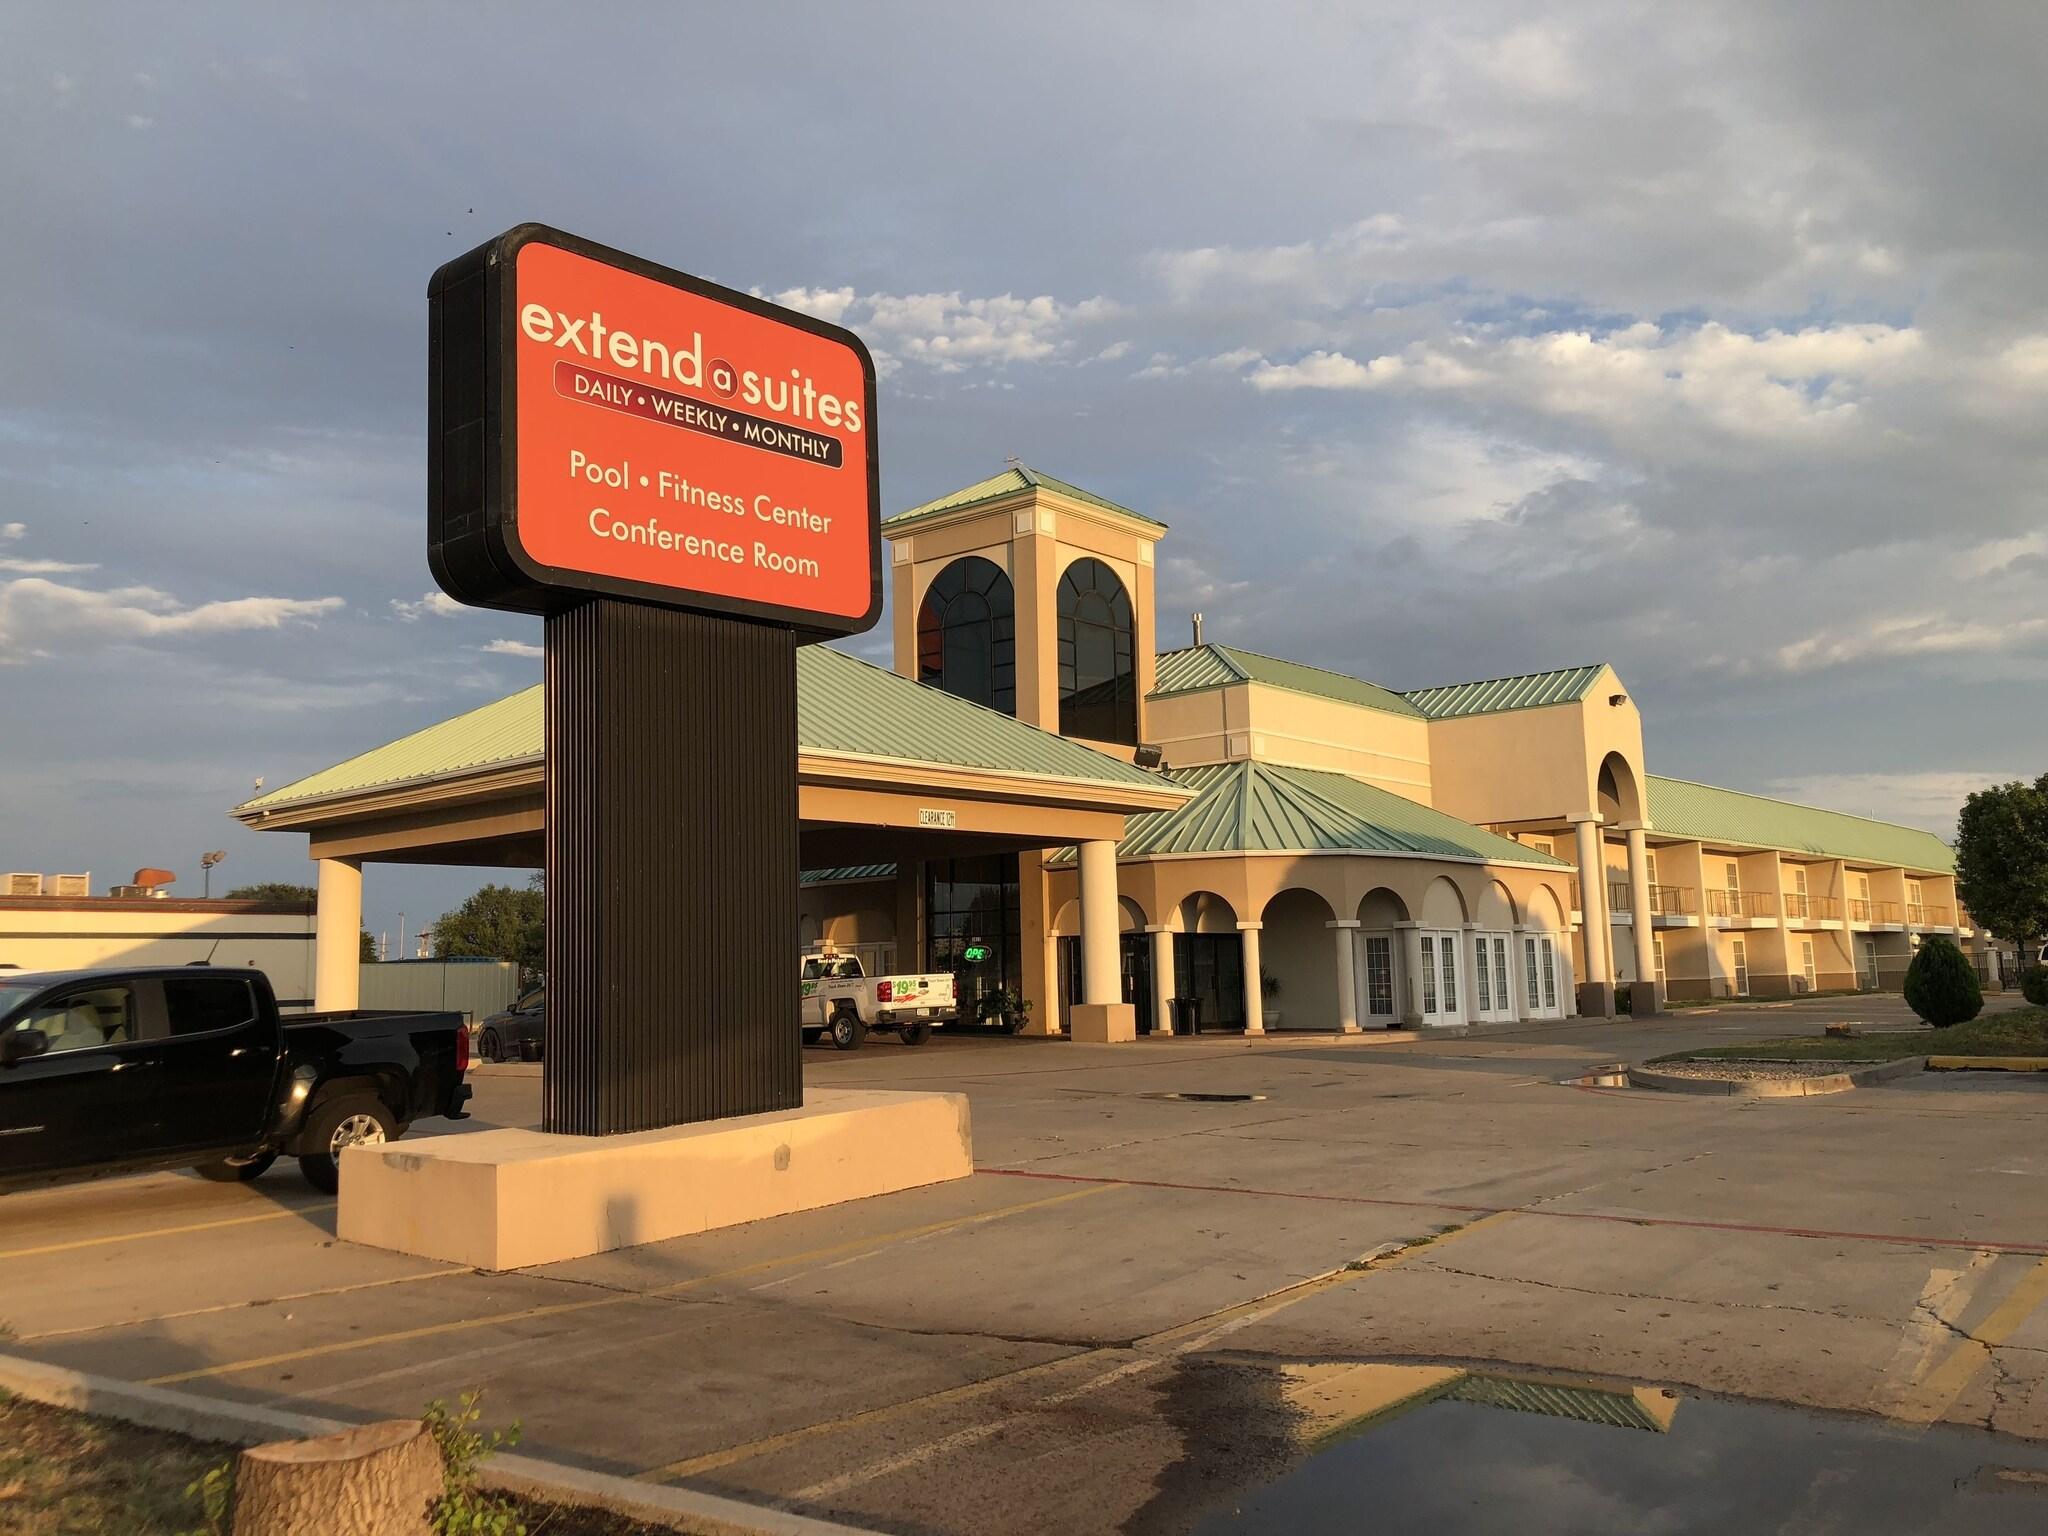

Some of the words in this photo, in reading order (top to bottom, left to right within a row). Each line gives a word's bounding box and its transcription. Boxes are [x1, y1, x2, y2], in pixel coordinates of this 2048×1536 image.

[520, 302, 704, 389] extend
[711, 366, 732, 394] a
[741, 368, 863, 434] suites
[575, 374, 633, 407] DAILY
[651, 394, 729, 433] WEEKLY
[743, 420, 831, 460] MONTHLY
[570, 450, 629, 490] Pool
[659, 471, 745, 516] Fitness
[753, 494, 832, 534] Center
[588, 508, 745, 564] Conference
[753, 540, 820, 579] Room
[920, 810, 945, 826] CLEARANCE
